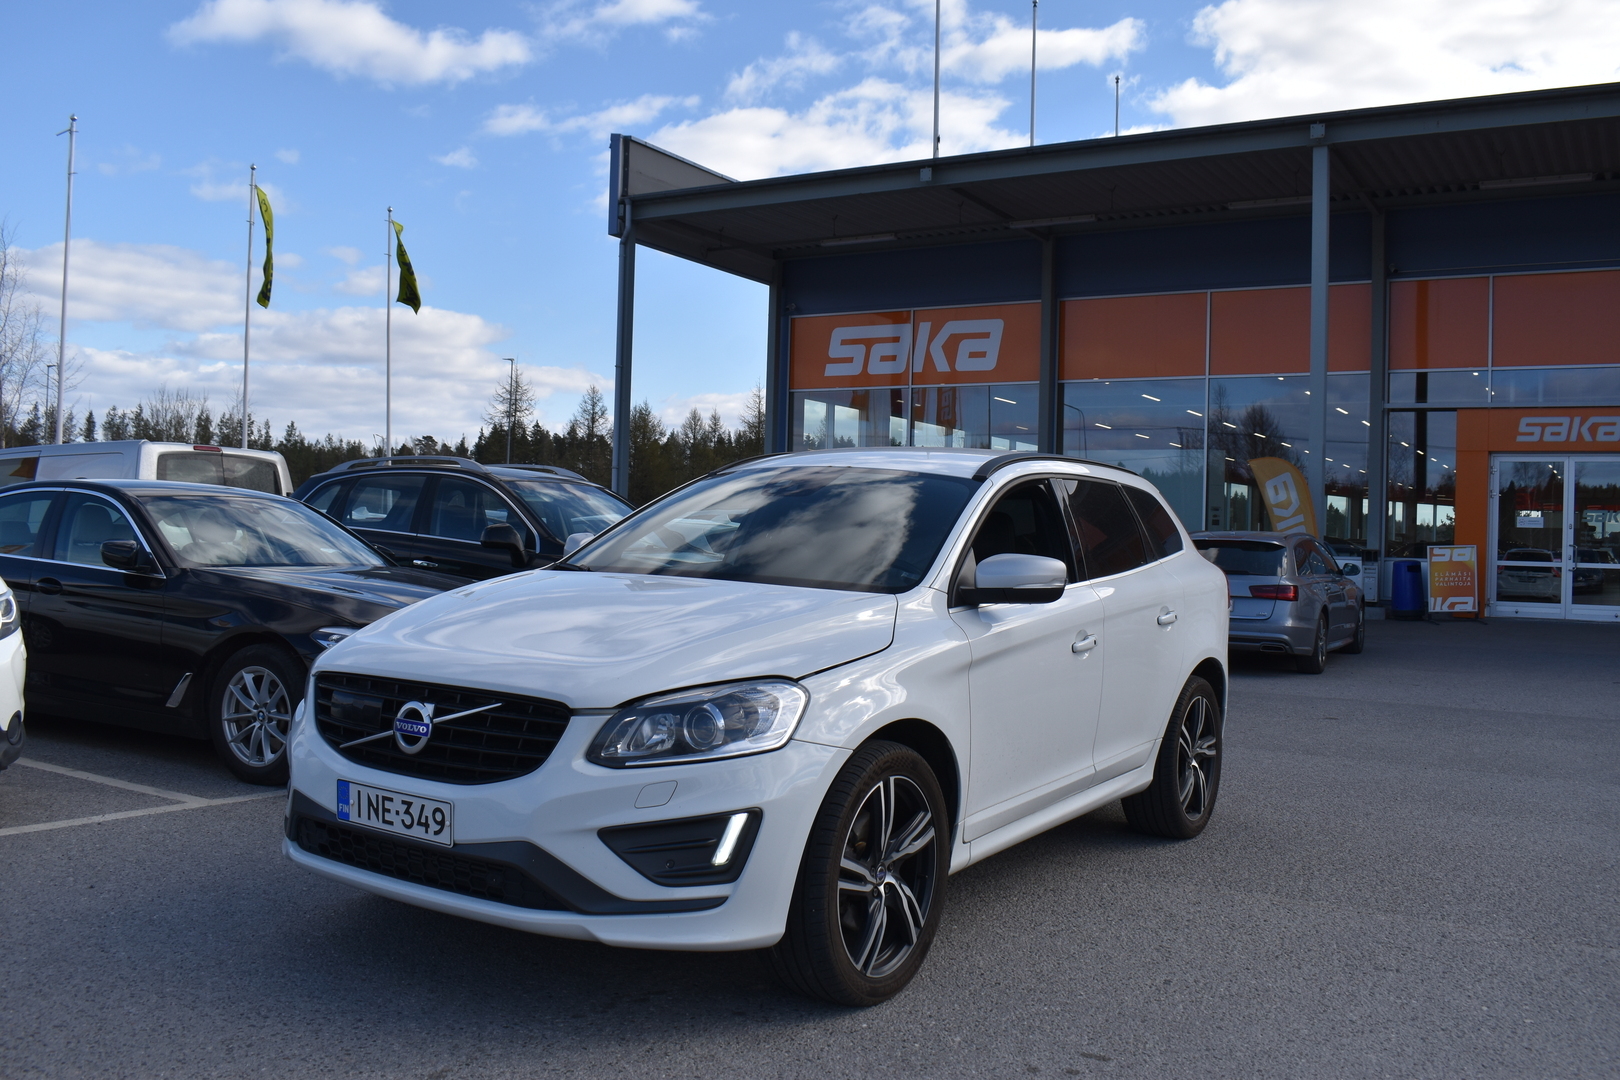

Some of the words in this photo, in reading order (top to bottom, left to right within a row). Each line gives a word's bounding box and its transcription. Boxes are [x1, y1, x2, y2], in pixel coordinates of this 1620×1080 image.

[396, 721, 427, 734] VOLVO
[338, 803, 349, 814] FIN
[357, 790, 446, 836] INE-349
